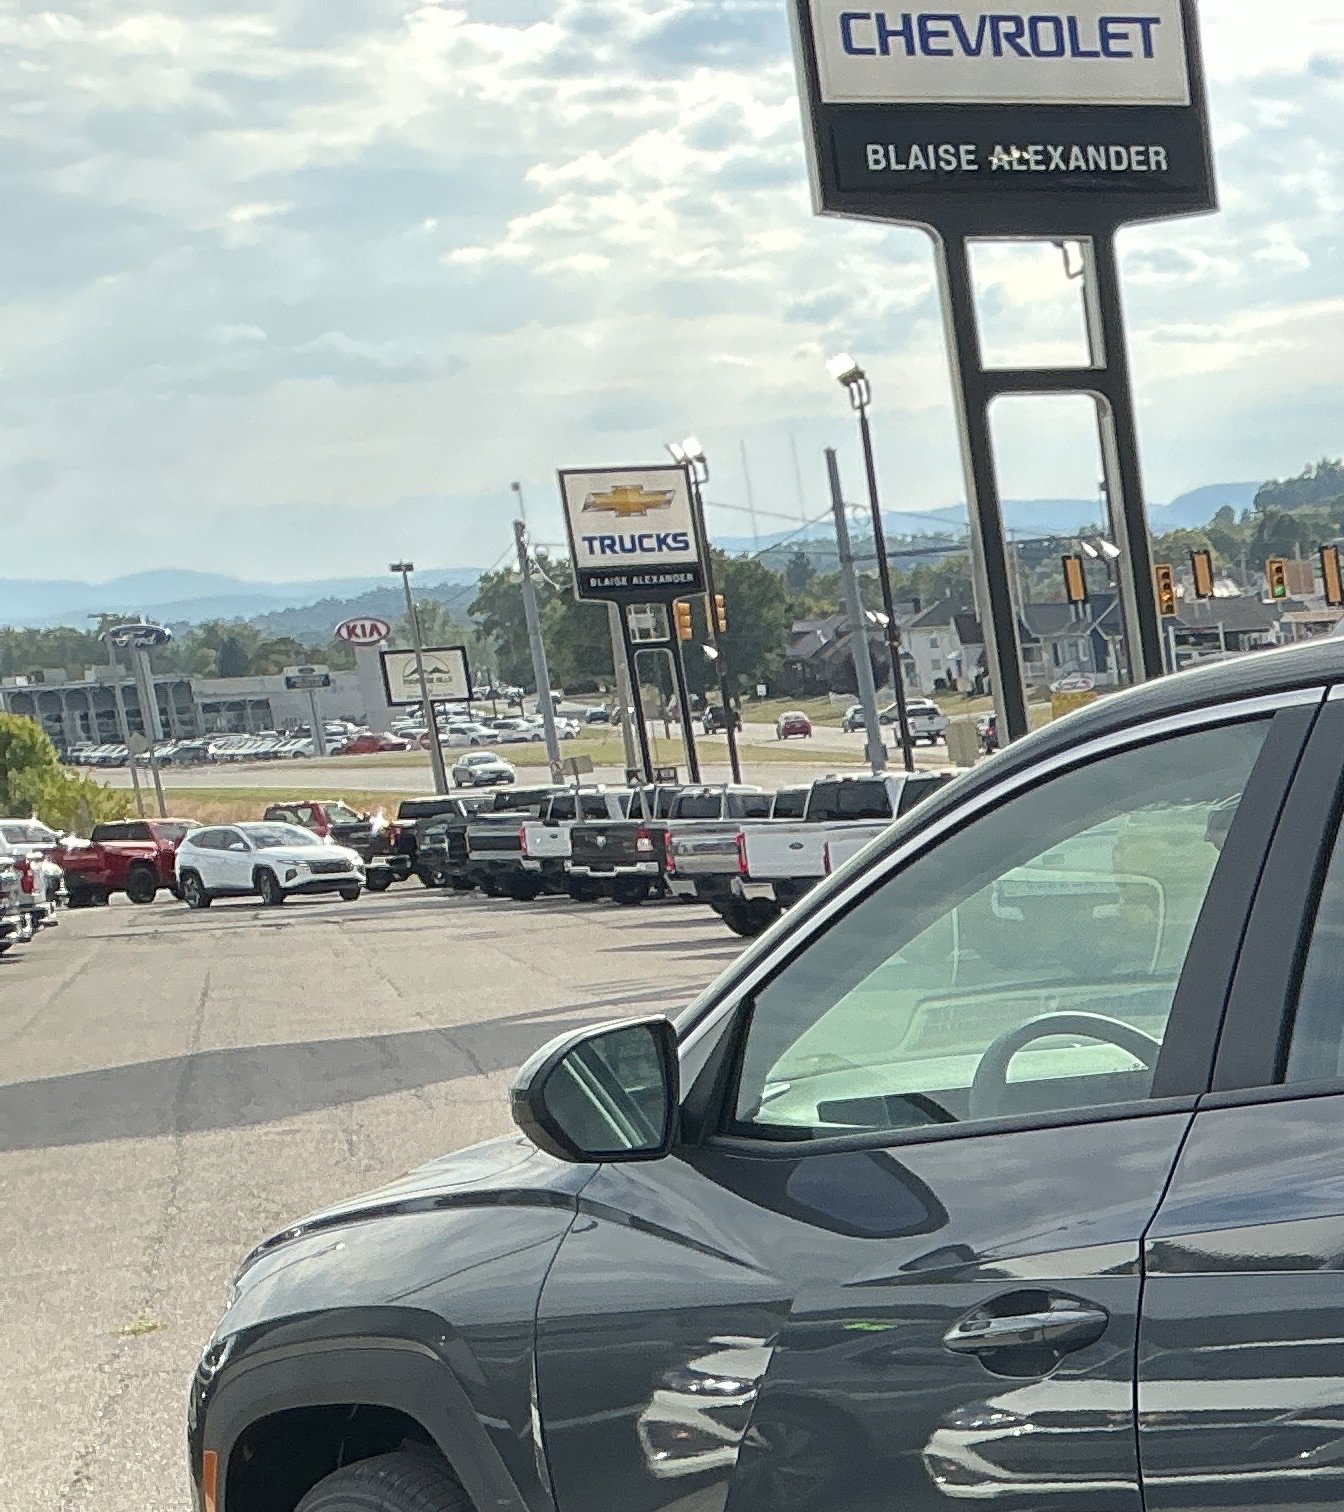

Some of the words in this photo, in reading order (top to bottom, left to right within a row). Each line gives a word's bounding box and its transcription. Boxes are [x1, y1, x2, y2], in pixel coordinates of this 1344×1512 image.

[840, 11, 1162, 59] CHEVROLET
[866, 144, 978, 171] BLAISE
[988, 144, 1168, 172] ALEXANDER
[581, 532, 690, 555] TRUCKS
[590, 576, 628, 588] BLAISE
[632, 573, 694, 586] ALEXANDER
[346, 623, 383, 639] KIA
